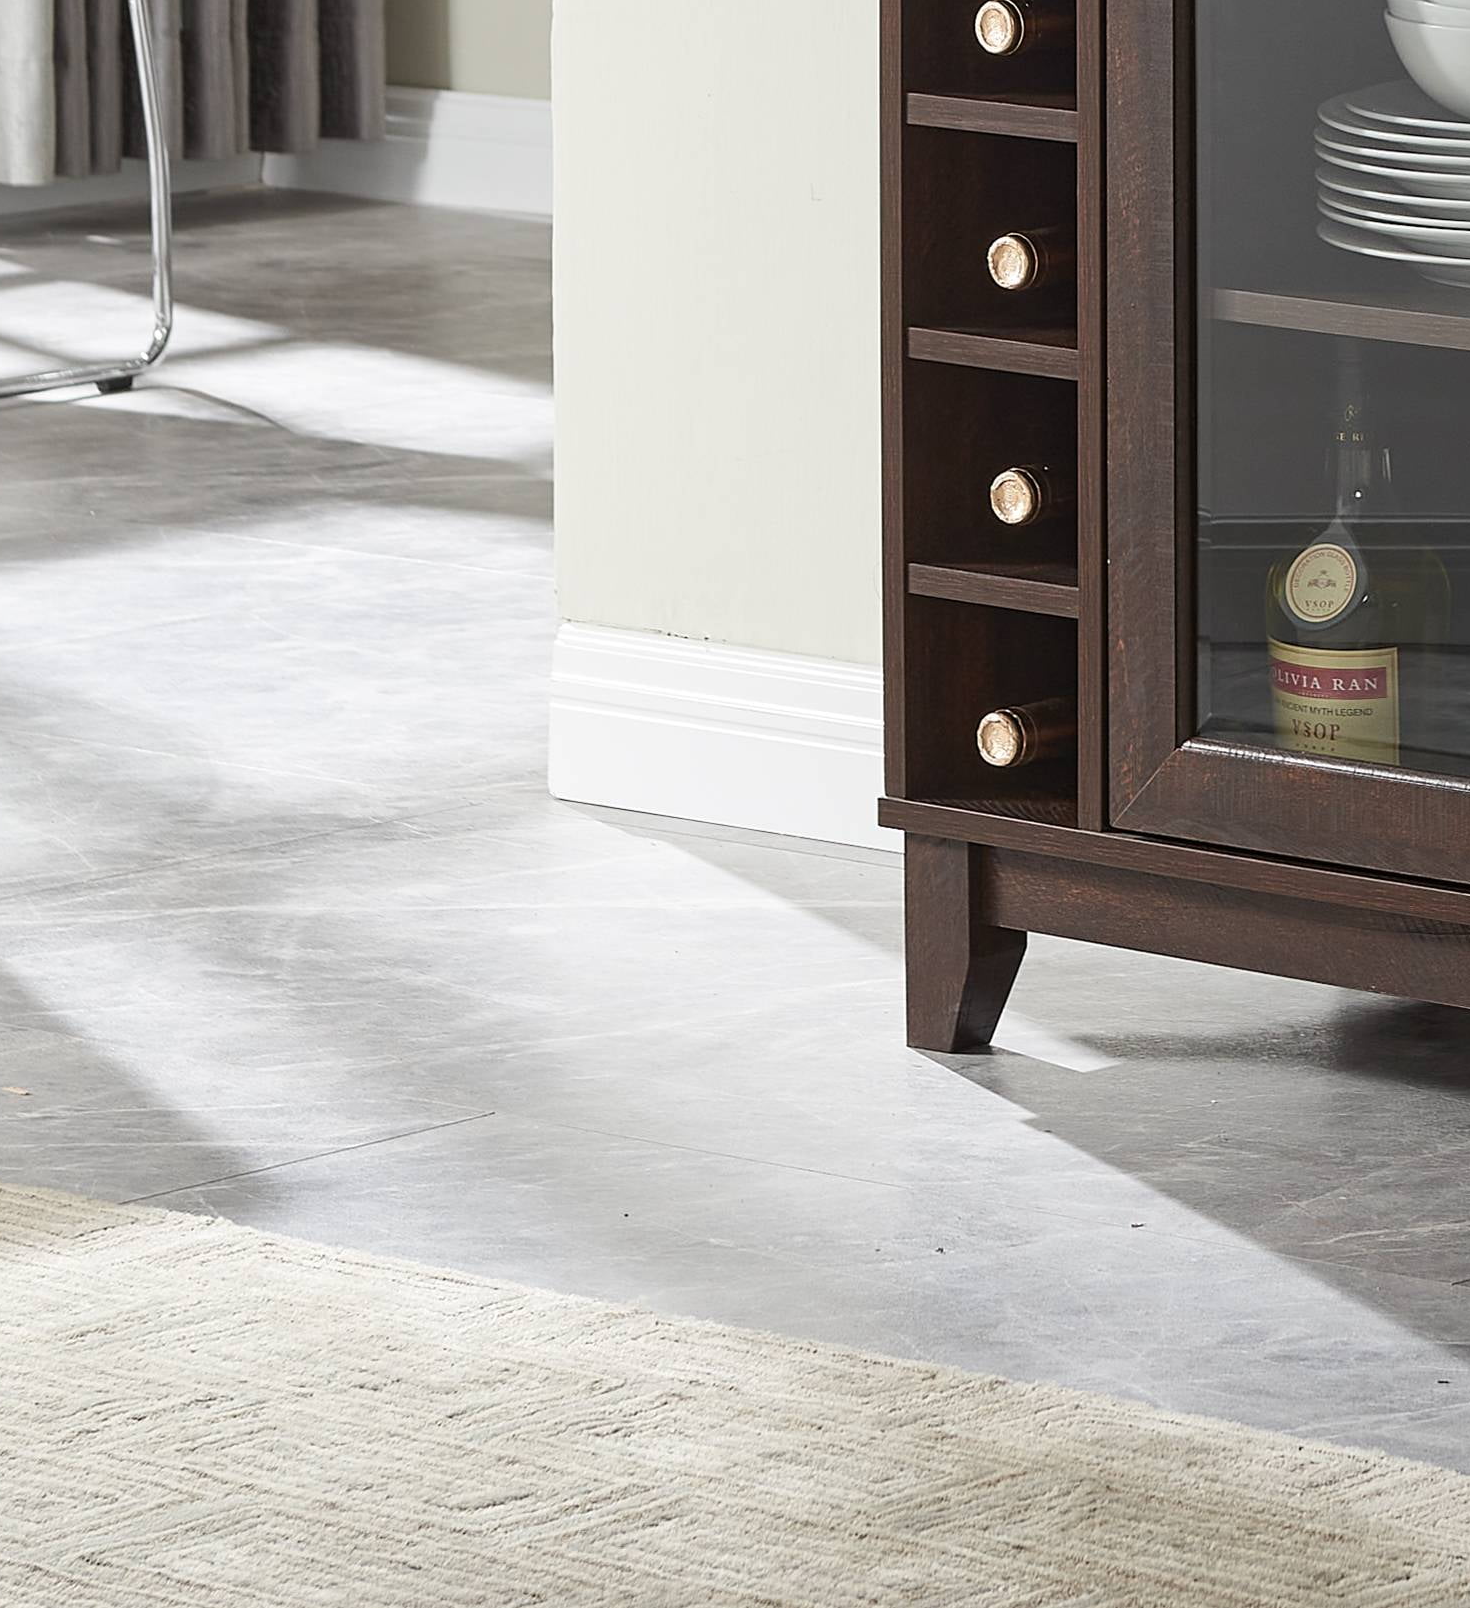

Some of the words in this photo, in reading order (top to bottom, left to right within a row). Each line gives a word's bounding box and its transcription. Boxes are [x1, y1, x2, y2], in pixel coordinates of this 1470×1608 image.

[1304, 600, 1335, 609] VSOP
[1332, 678, 1378, 691] RAN
[1292, 719, 1341, 741] VSOP
